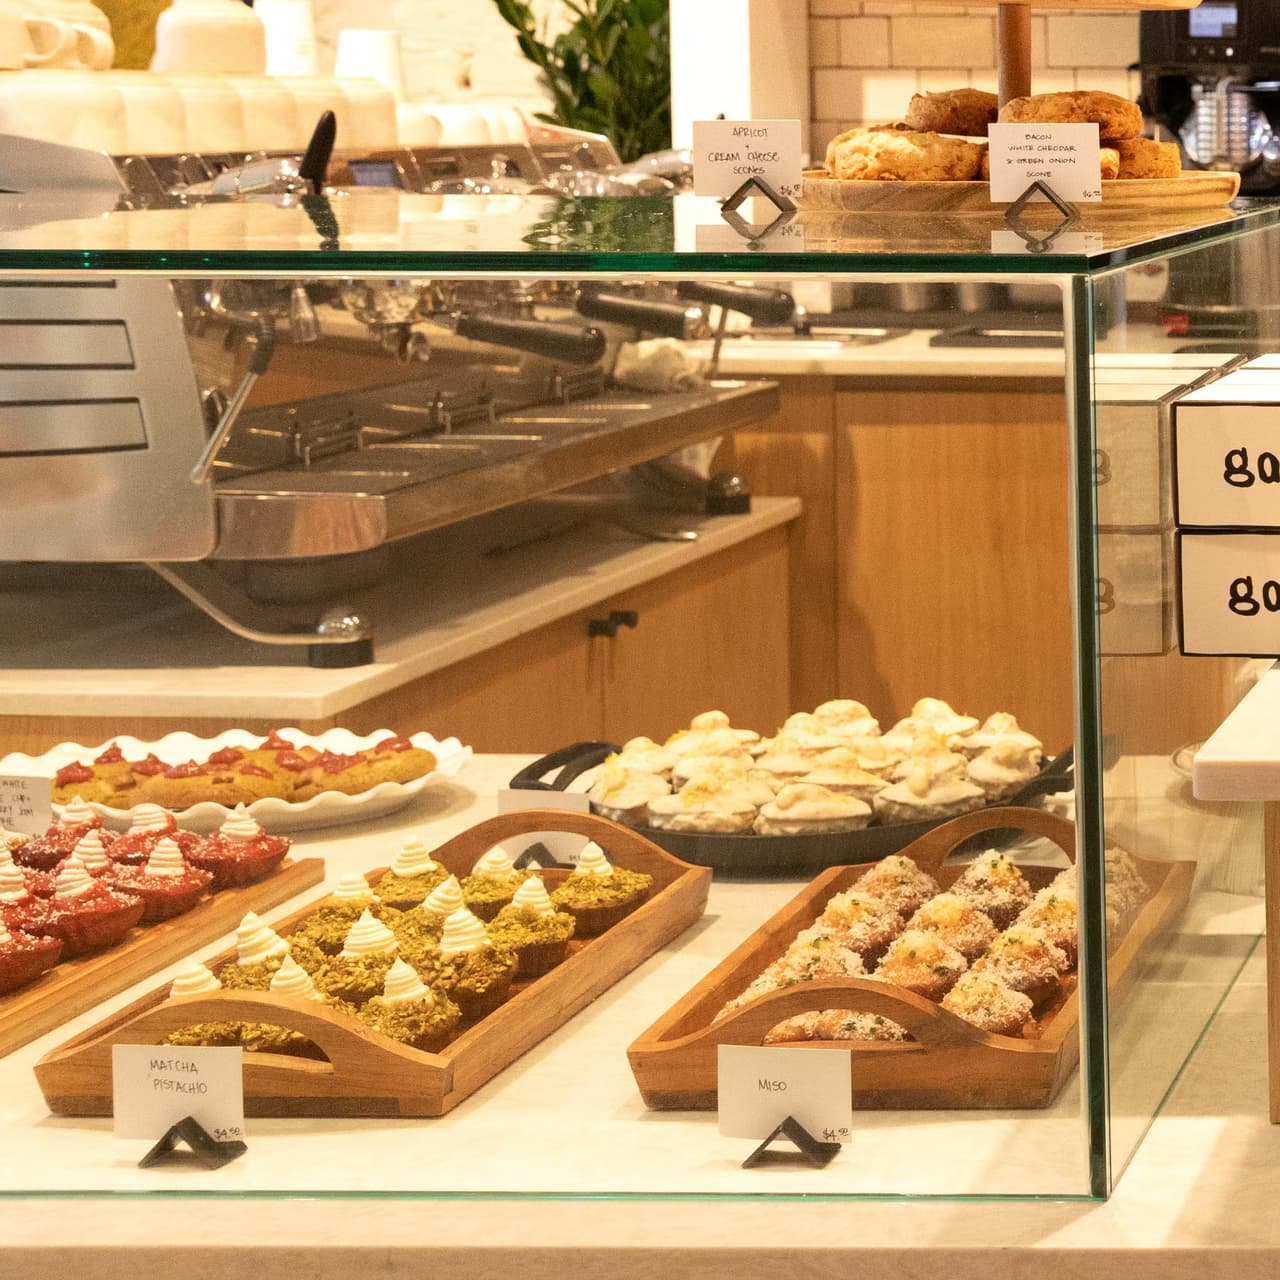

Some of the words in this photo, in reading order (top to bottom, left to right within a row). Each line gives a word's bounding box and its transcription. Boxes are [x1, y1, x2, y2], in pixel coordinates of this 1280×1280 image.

[732, 127, 769, 137] APRICOT
[1025, 133, 1053, 141] BACON
[707, 151, 742, 162] CREAM
[149, 1059, 199, 1074] MATCHA
[153, 1078, 208, 1095] PISTACHIO
[758, 1079, 788, 1092] MISO
